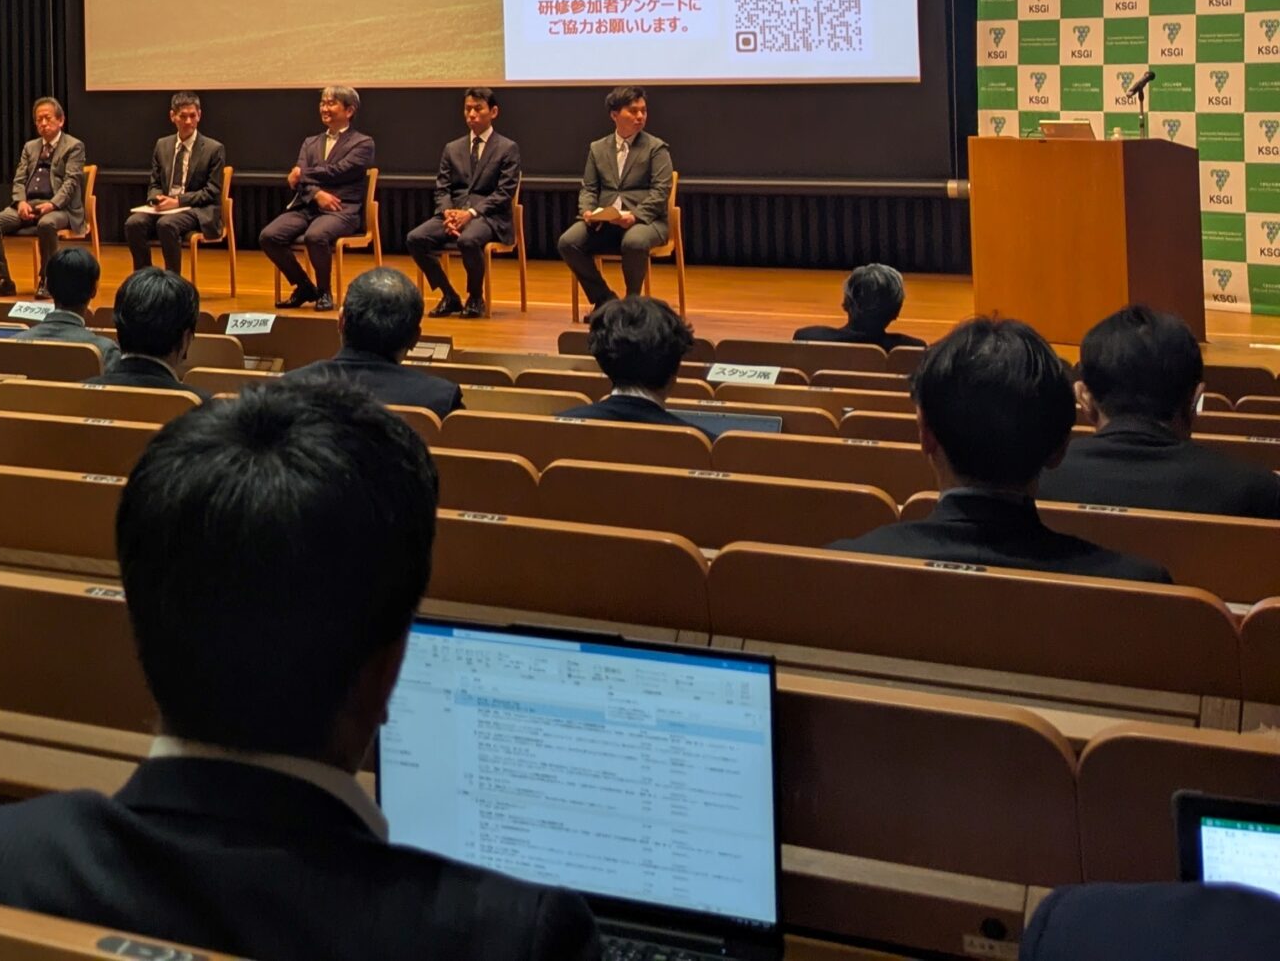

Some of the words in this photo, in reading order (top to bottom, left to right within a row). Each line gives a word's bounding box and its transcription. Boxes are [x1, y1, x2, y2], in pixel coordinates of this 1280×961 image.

[548, 16, 690, 35] ご協力お願いします。
[1257, 45, 1280, 55] KSG
[1257, 146, 1280, 156] KSG
[1259, 247, 1280, 258] KSG
